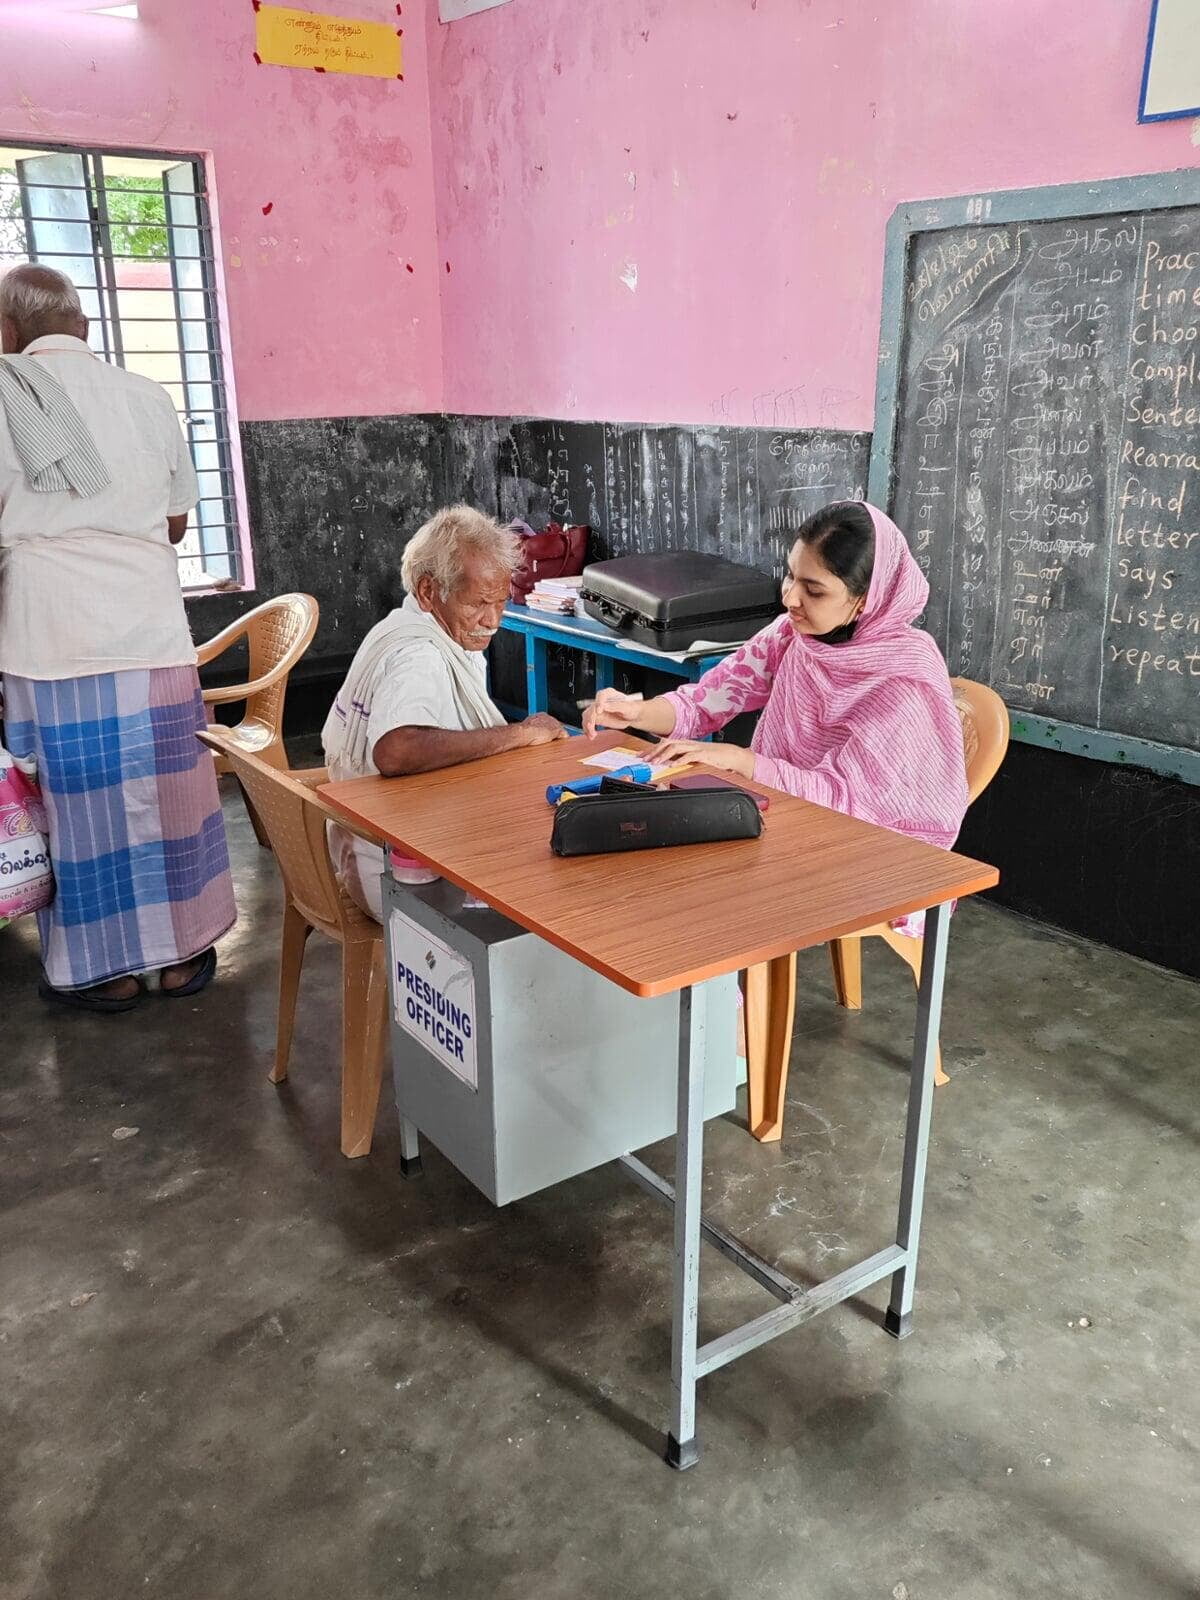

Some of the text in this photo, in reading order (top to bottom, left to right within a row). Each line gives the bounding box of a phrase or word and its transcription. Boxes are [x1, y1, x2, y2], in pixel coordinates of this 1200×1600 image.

[1130, 352, 1200, 399] Compl
[397, 960, 473, 1039] PRESIDING
[406, 997, 464, 1062] OFFICER
